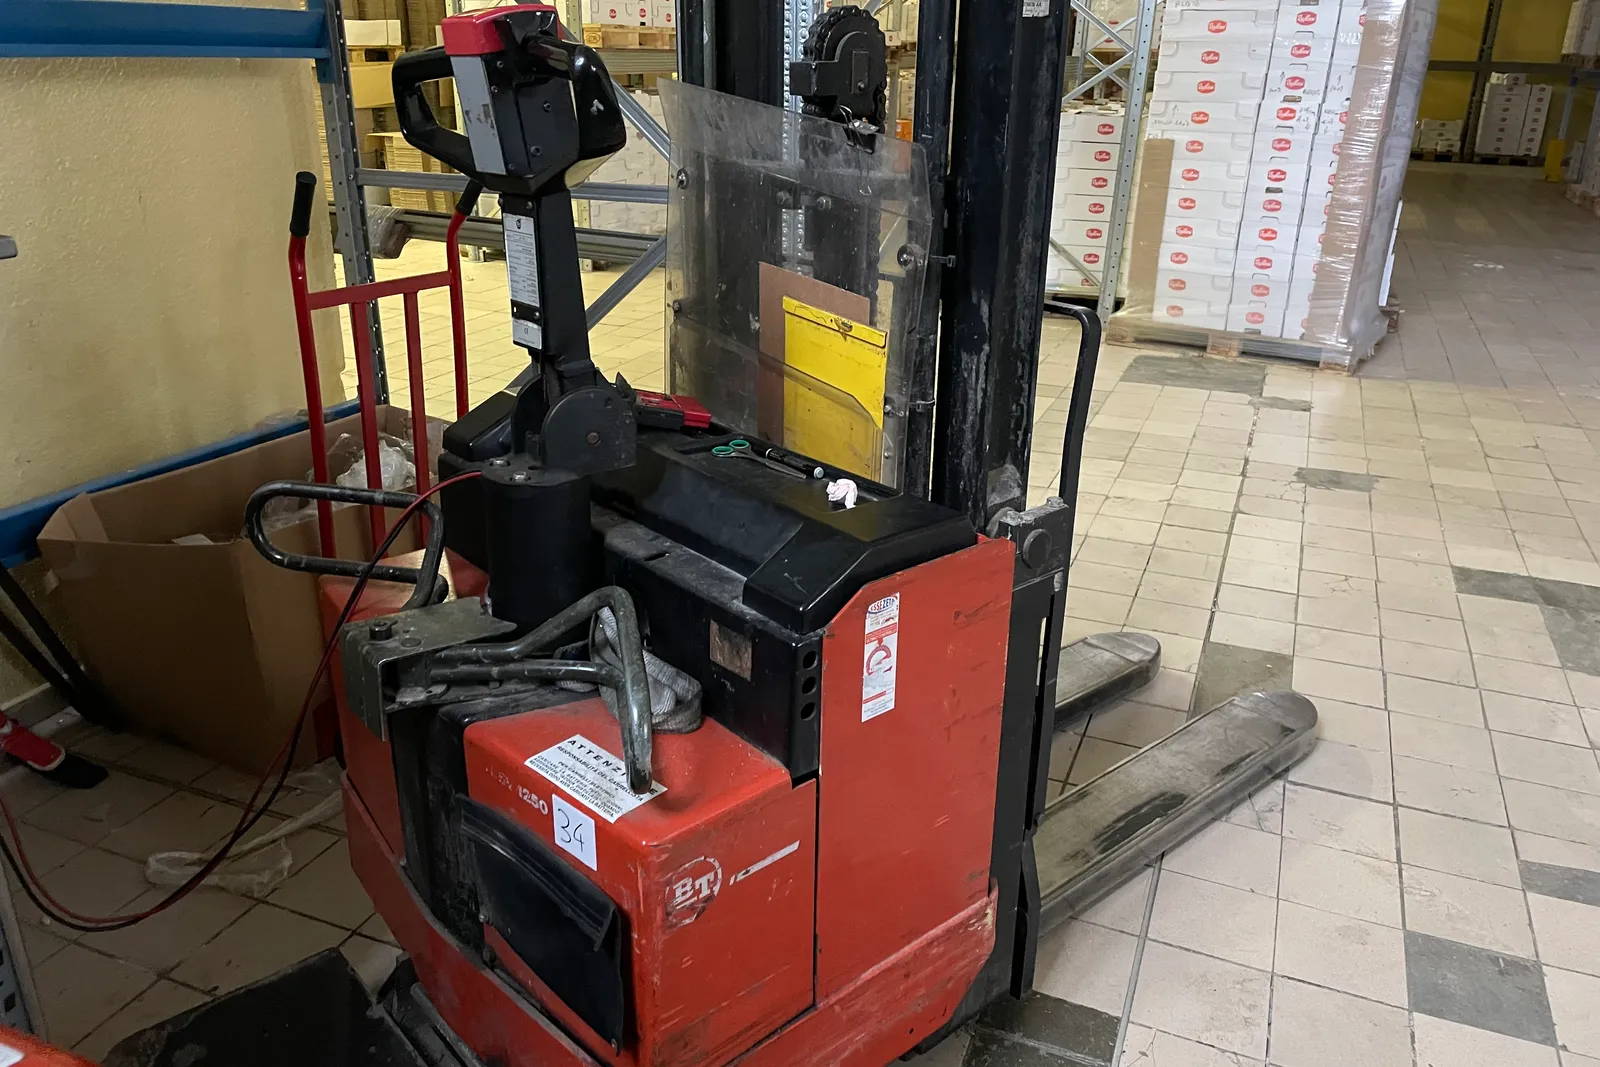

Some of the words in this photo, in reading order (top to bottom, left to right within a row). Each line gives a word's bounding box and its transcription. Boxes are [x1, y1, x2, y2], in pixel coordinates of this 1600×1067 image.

[566, 738, 658, 795] ATTENZIE
[595, 770, 609, 779] DEL
[517, 785, 549, 815] 1250
[557, 808, 585, 852] 34
[673, 871, 714, 905] BT
